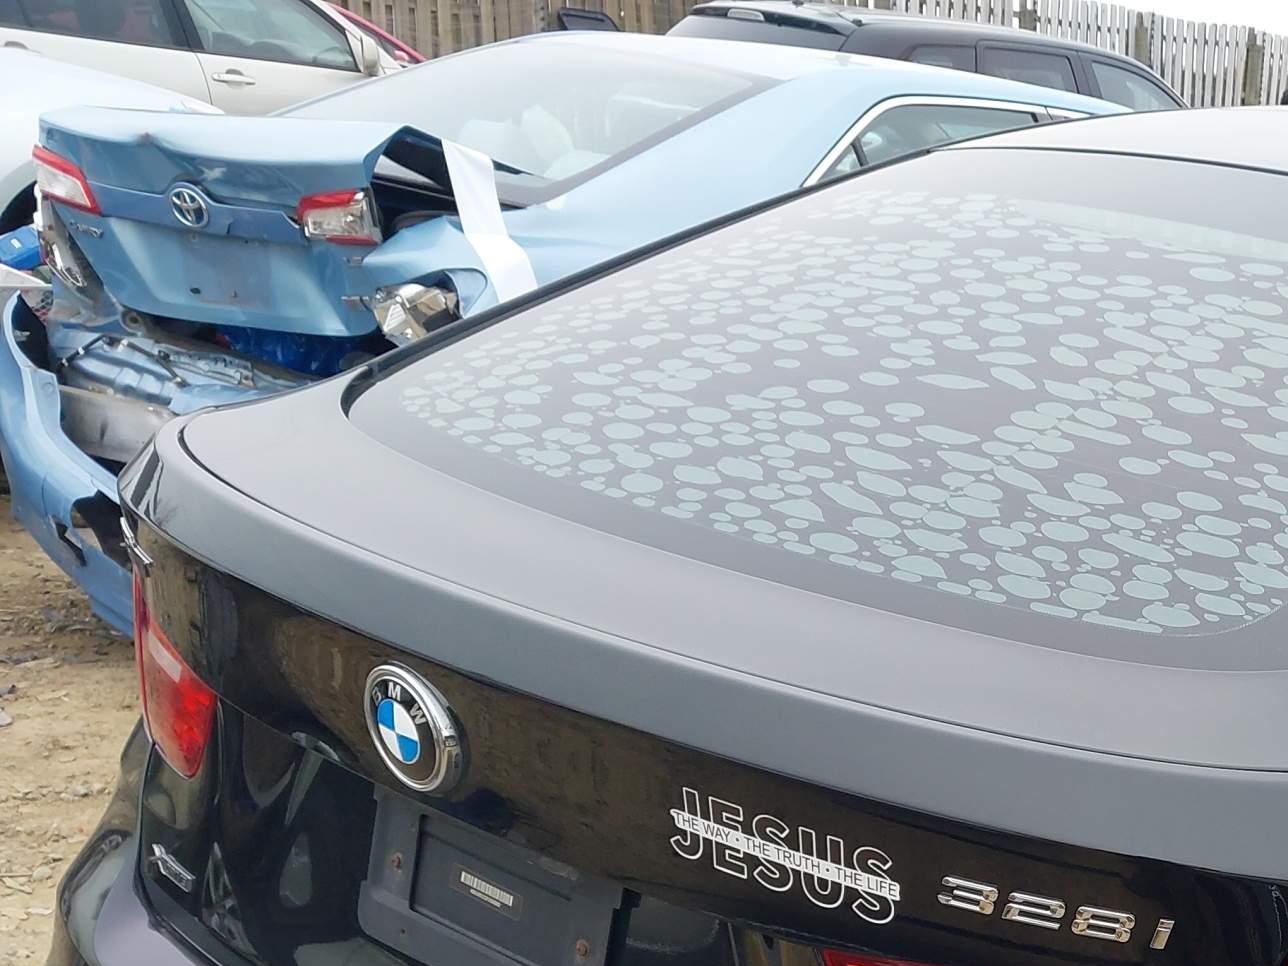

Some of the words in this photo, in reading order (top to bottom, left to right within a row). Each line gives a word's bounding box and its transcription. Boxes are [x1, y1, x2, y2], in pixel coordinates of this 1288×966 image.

[371, 682, 427, 726] BMW
[670, 787, 895, 924] JESUS
[674, 811, 701, 833] THE
[702, 822, 731, 843] WAY
[744, 836, 771, 858] THE
[774, 847, 821, 875] TRUTH
[834, 866, 863, 888] THE
[866, 877, 897, 898] LIFE
